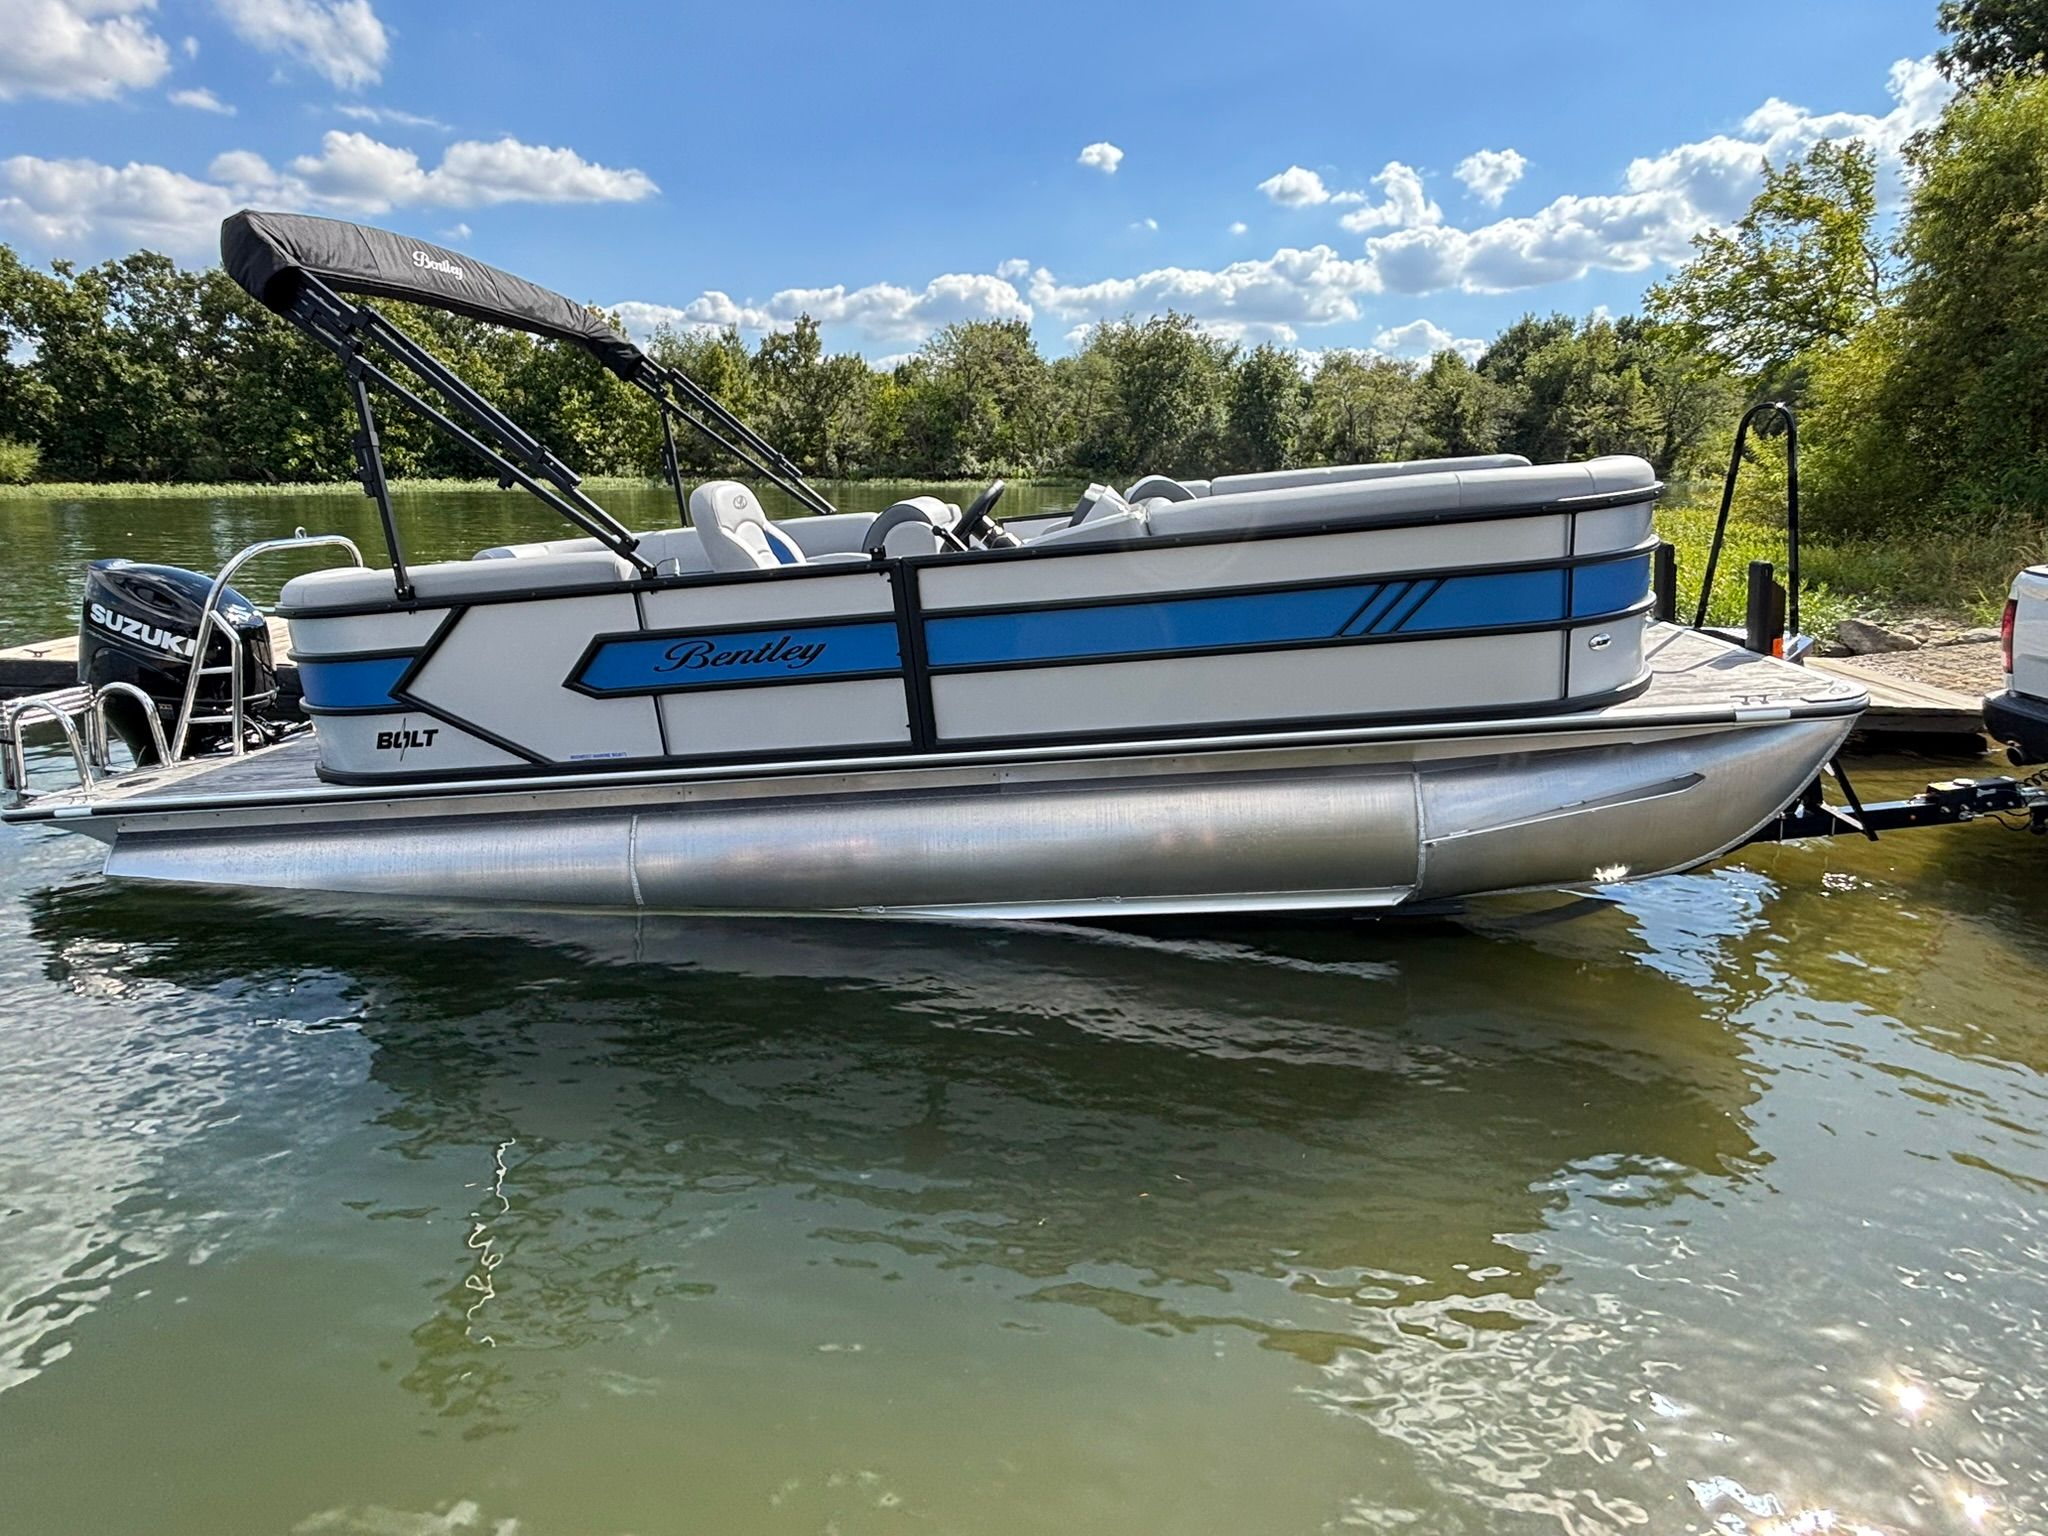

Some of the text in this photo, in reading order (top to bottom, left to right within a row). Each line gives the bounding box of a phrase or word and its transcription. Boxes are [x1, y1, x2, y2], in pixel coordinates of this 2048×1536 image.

[412, 250, 463, 281] Bentley
[90, 603, 197, 657] SUZUKI
[653, 635, 827, 672] Bentley
[376, 728, 439, 750] BOLT
